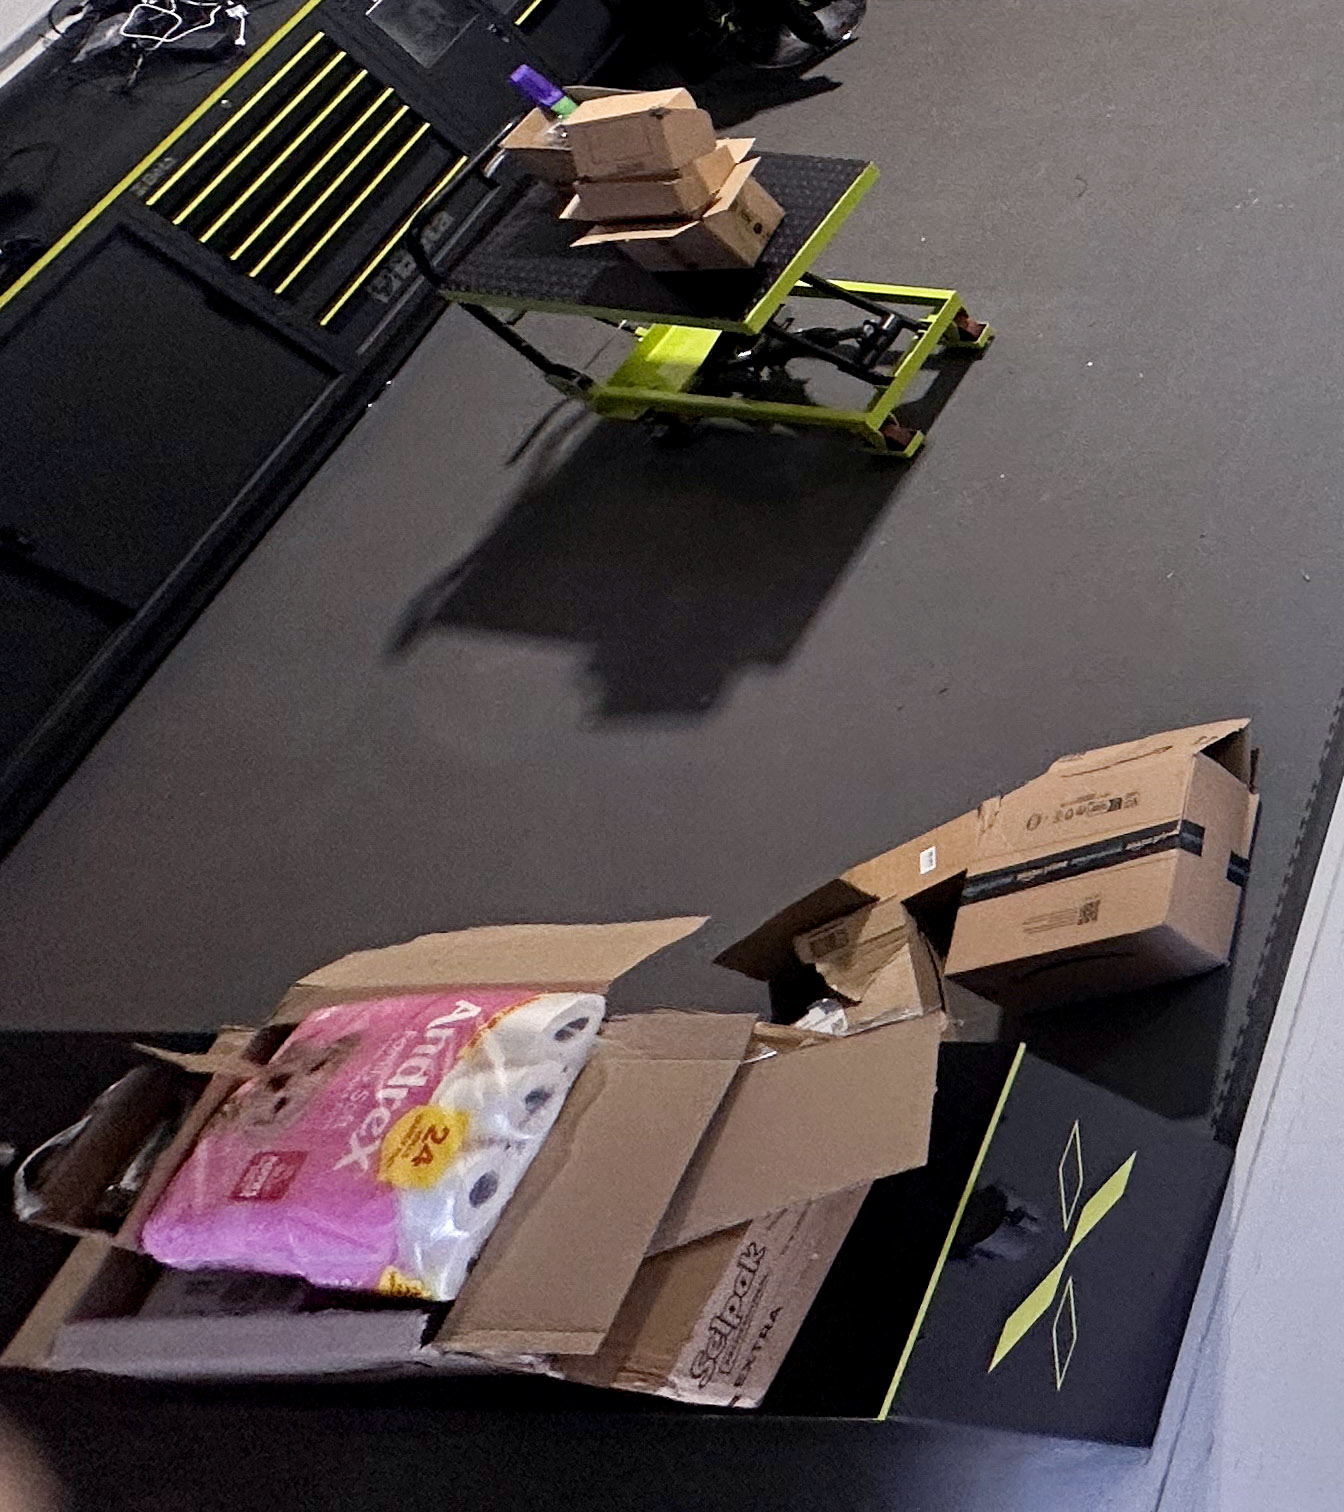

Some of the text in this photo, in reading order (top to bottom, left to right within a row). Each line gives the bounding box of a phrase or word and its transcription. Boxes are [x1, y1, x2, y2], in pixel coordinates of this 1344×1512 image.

[333, 999, 482, 1172] Andrex
[411, 1124, 450, 1167] 24
[688, 1240, 767, 1389] Selpak
